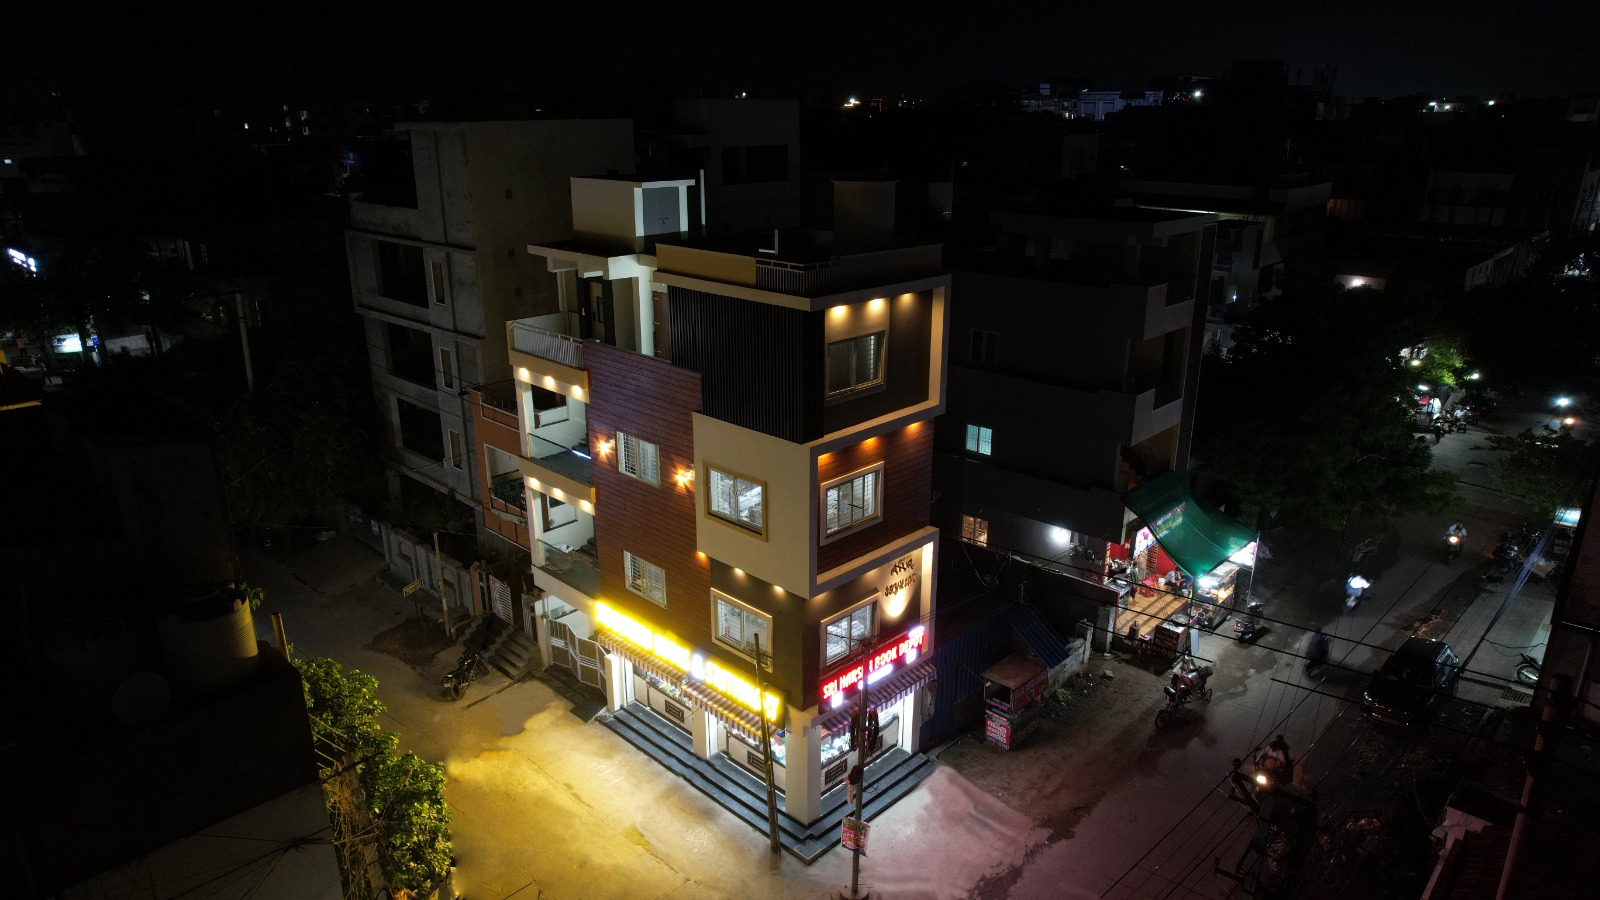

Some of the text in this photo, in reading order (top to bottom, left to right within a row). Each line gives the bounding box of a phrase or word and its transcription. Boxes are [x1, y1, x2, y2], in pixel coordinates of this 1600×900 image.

[823, 680, 837, 699] SRI
[874, 646, 897, 669] BOOK
[899, 632, 924, 656] DEPOT
